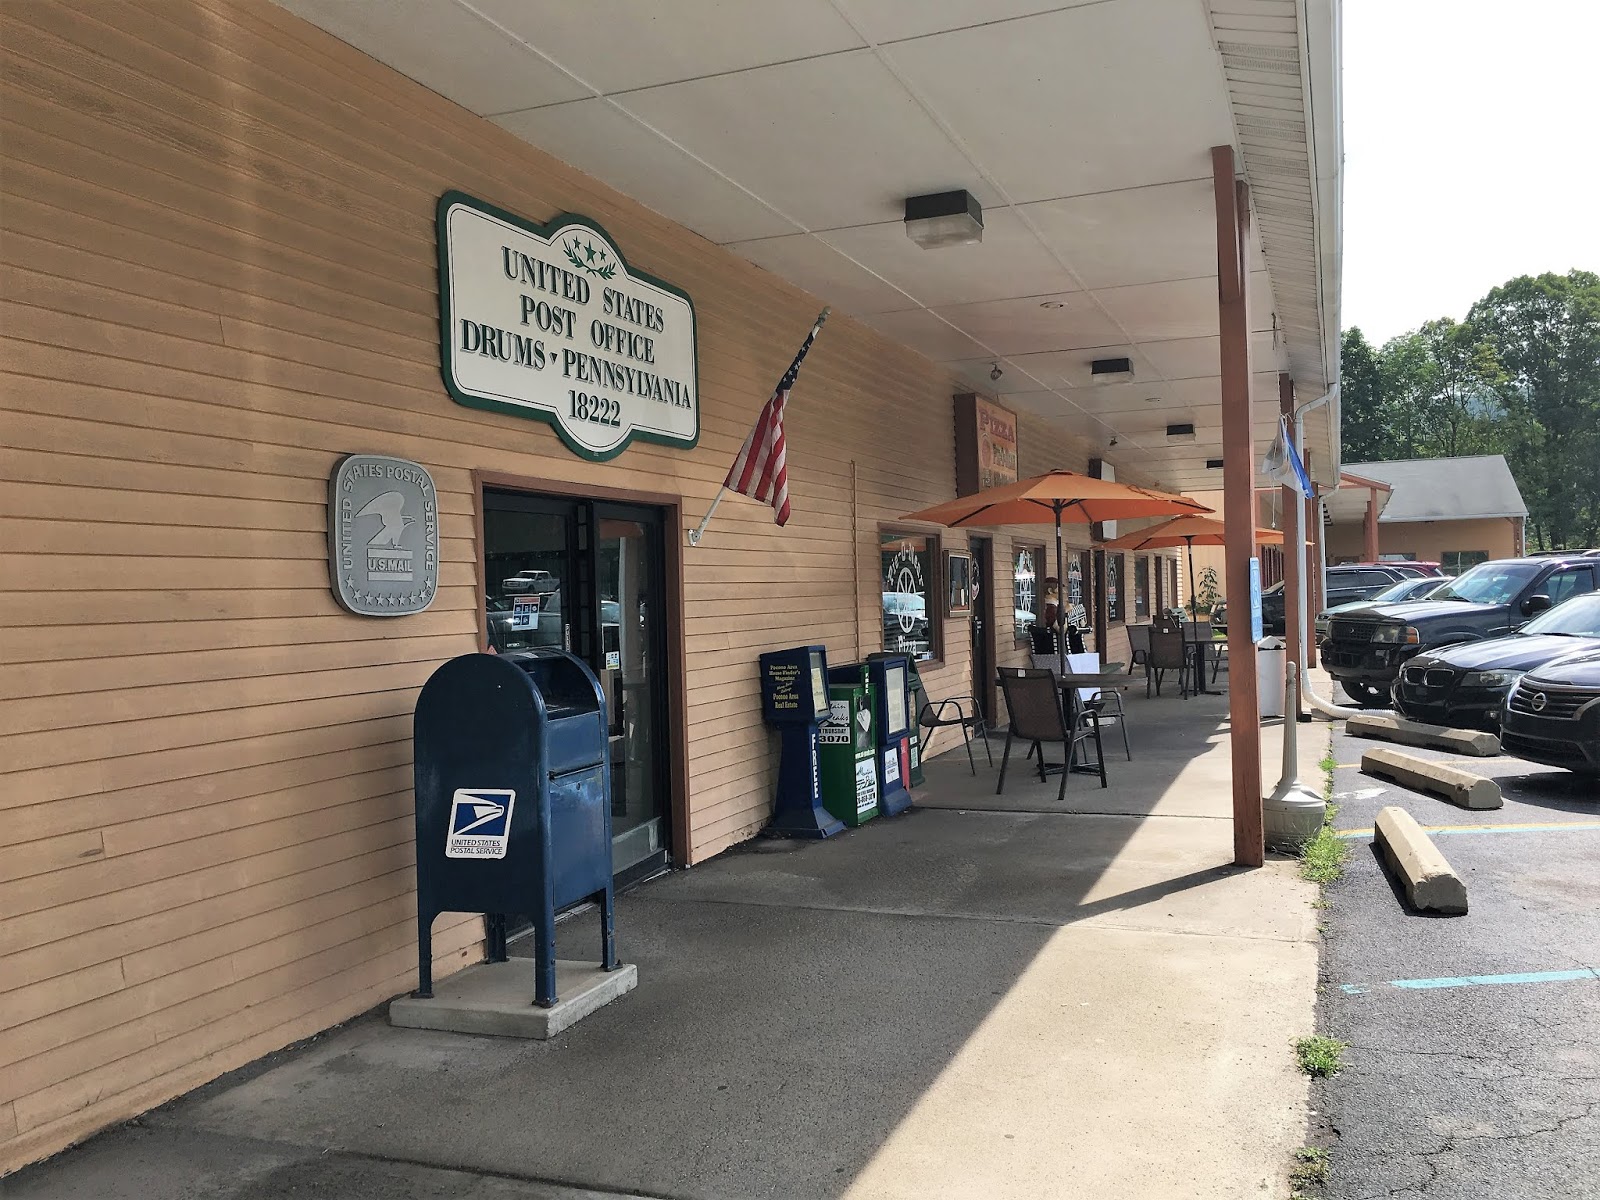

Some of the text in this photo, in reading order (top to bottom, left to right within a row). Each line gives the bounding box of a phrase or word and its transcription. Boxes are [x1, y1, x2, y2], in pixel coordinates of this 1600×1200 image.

[501, 246, 664, 333] UNITED STATES
[460, 318, 692, 409] DRUMS PENNSYLVANIA
[519, 294, 655, 364] POST OFFICE
[568, 390, 621, 427] 18222
[342, 464, 434, 571] UNITED STATES POSTAL SERVICE
[898, 635, 917, 656] Pizza
